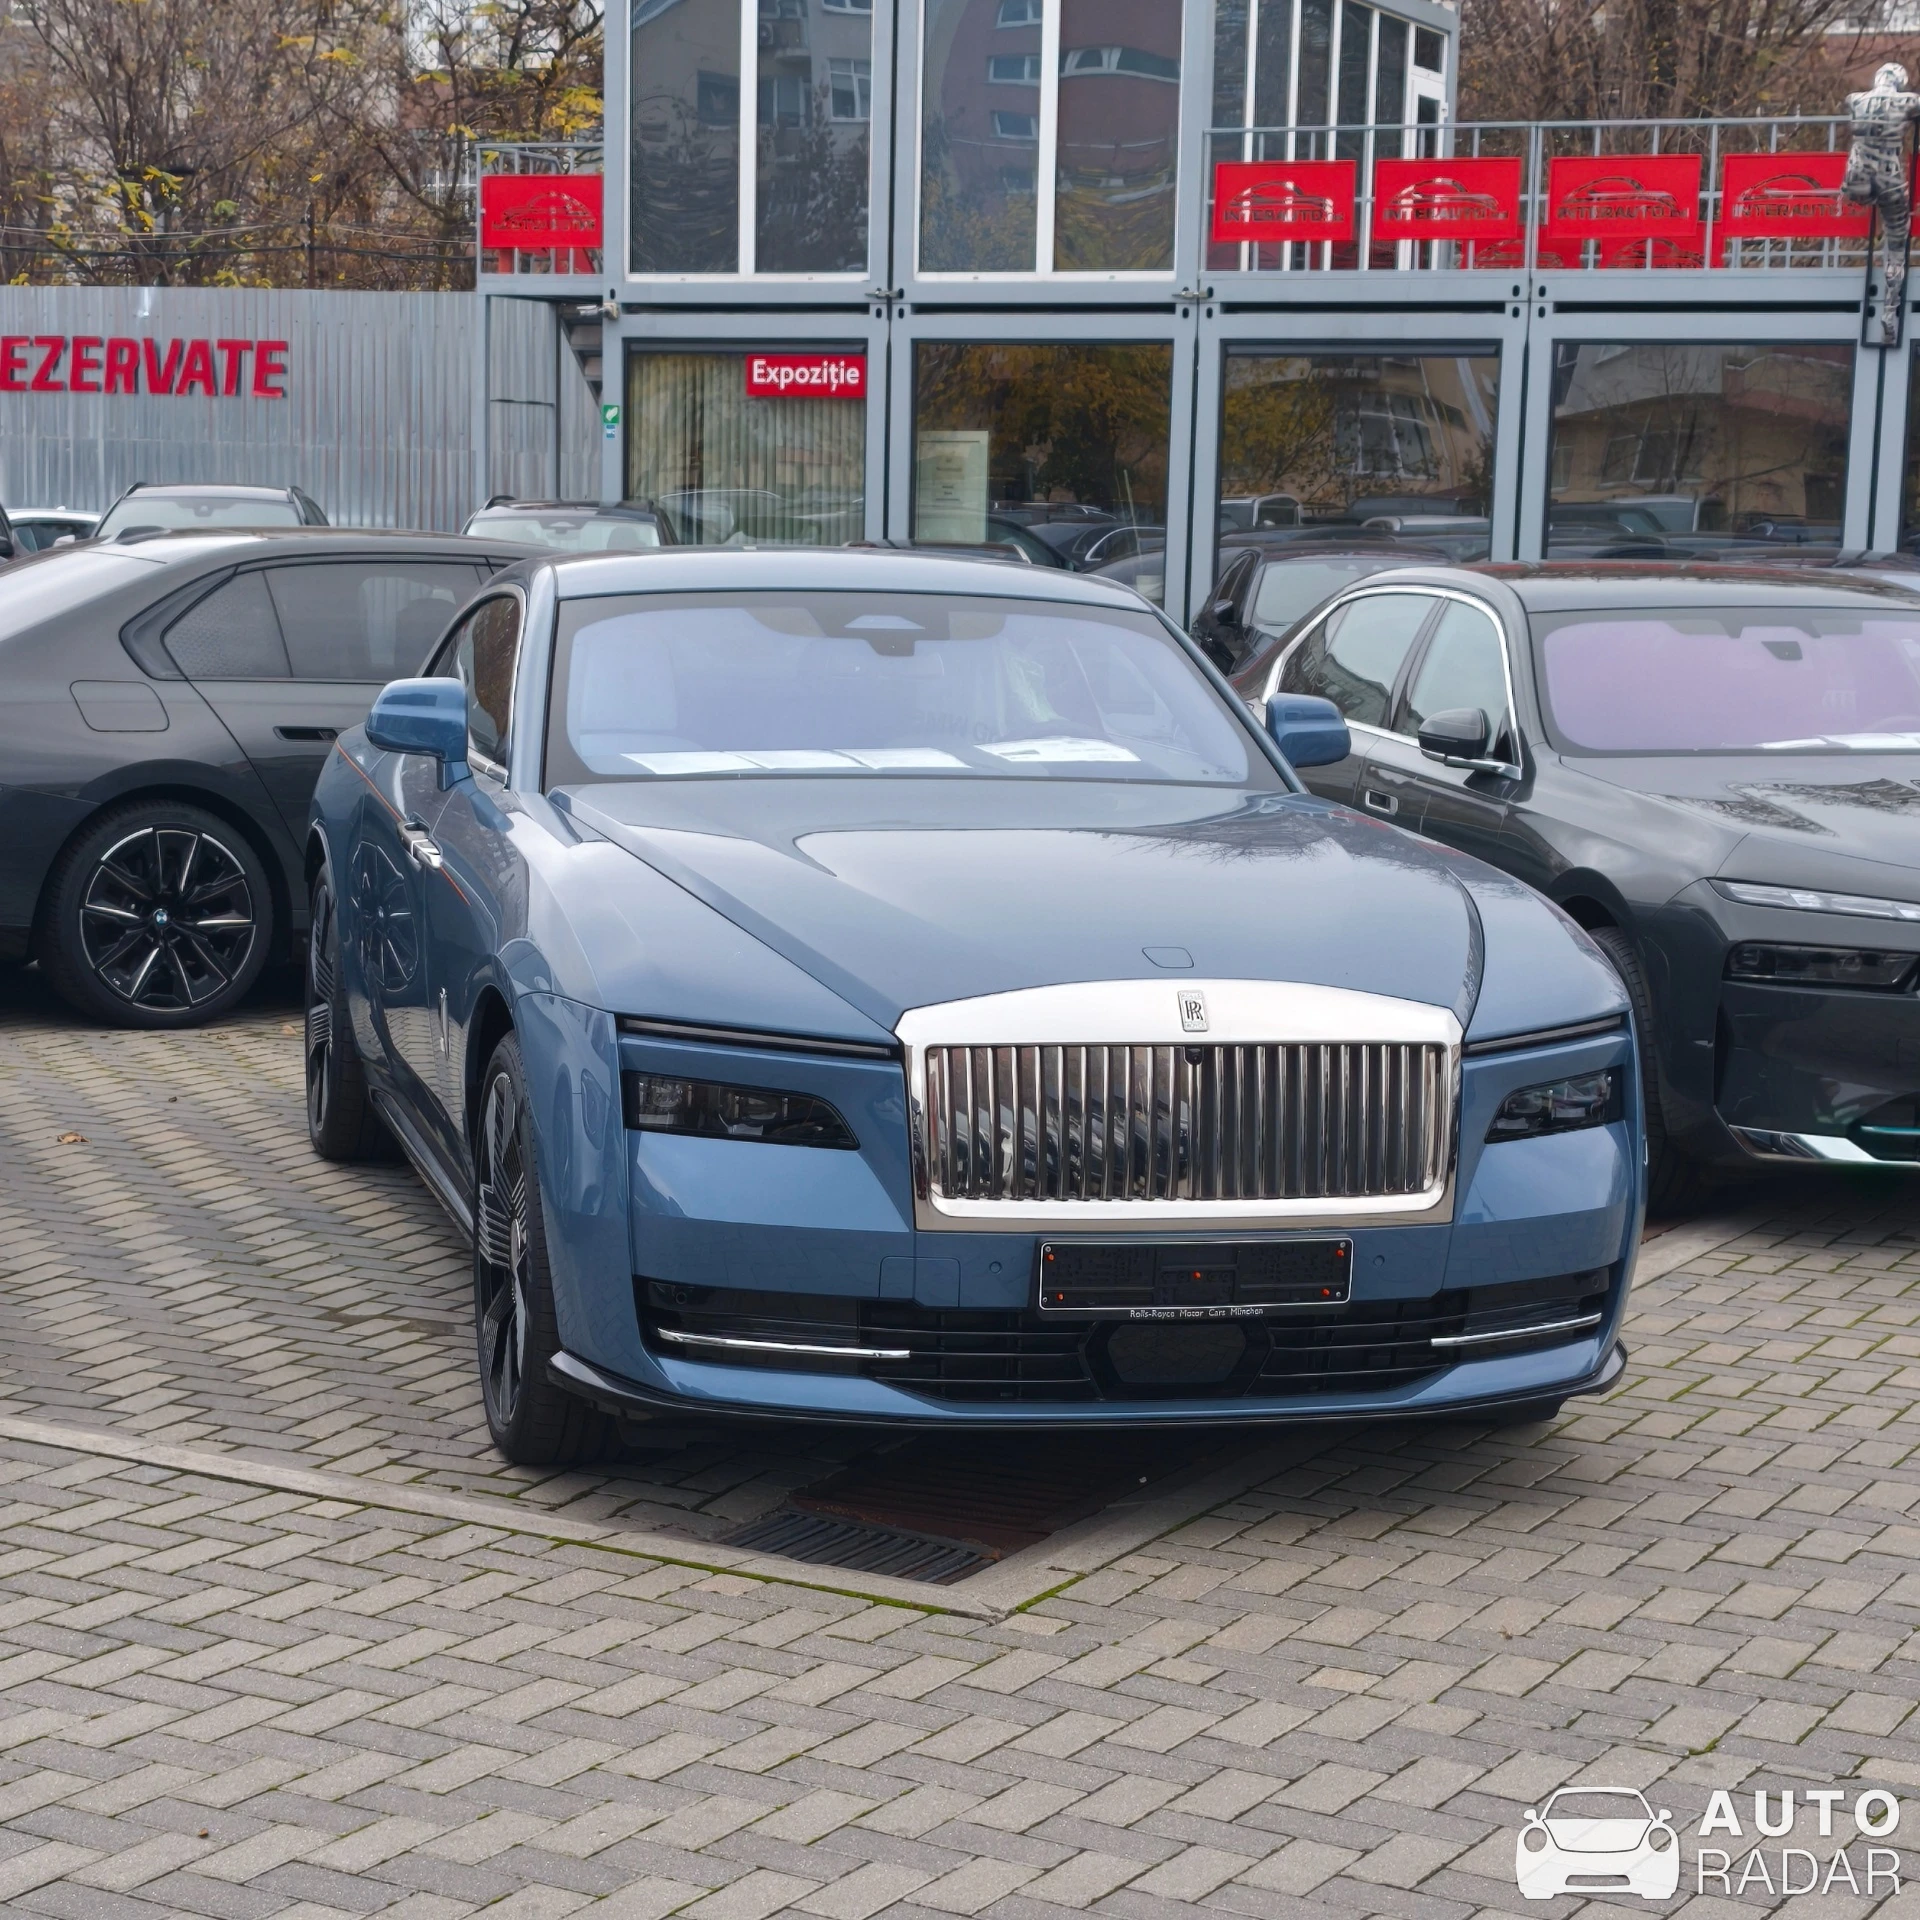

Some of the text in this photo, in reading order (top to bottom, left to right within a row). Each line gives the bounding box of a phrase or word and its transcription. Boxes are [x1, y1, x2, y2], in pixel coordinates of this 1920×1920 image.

[0, 336, 289, 398] EZERVATE
[752, 359, 860, 393] Expoziție
[1208, 1308, 1226, 1316] Cars
